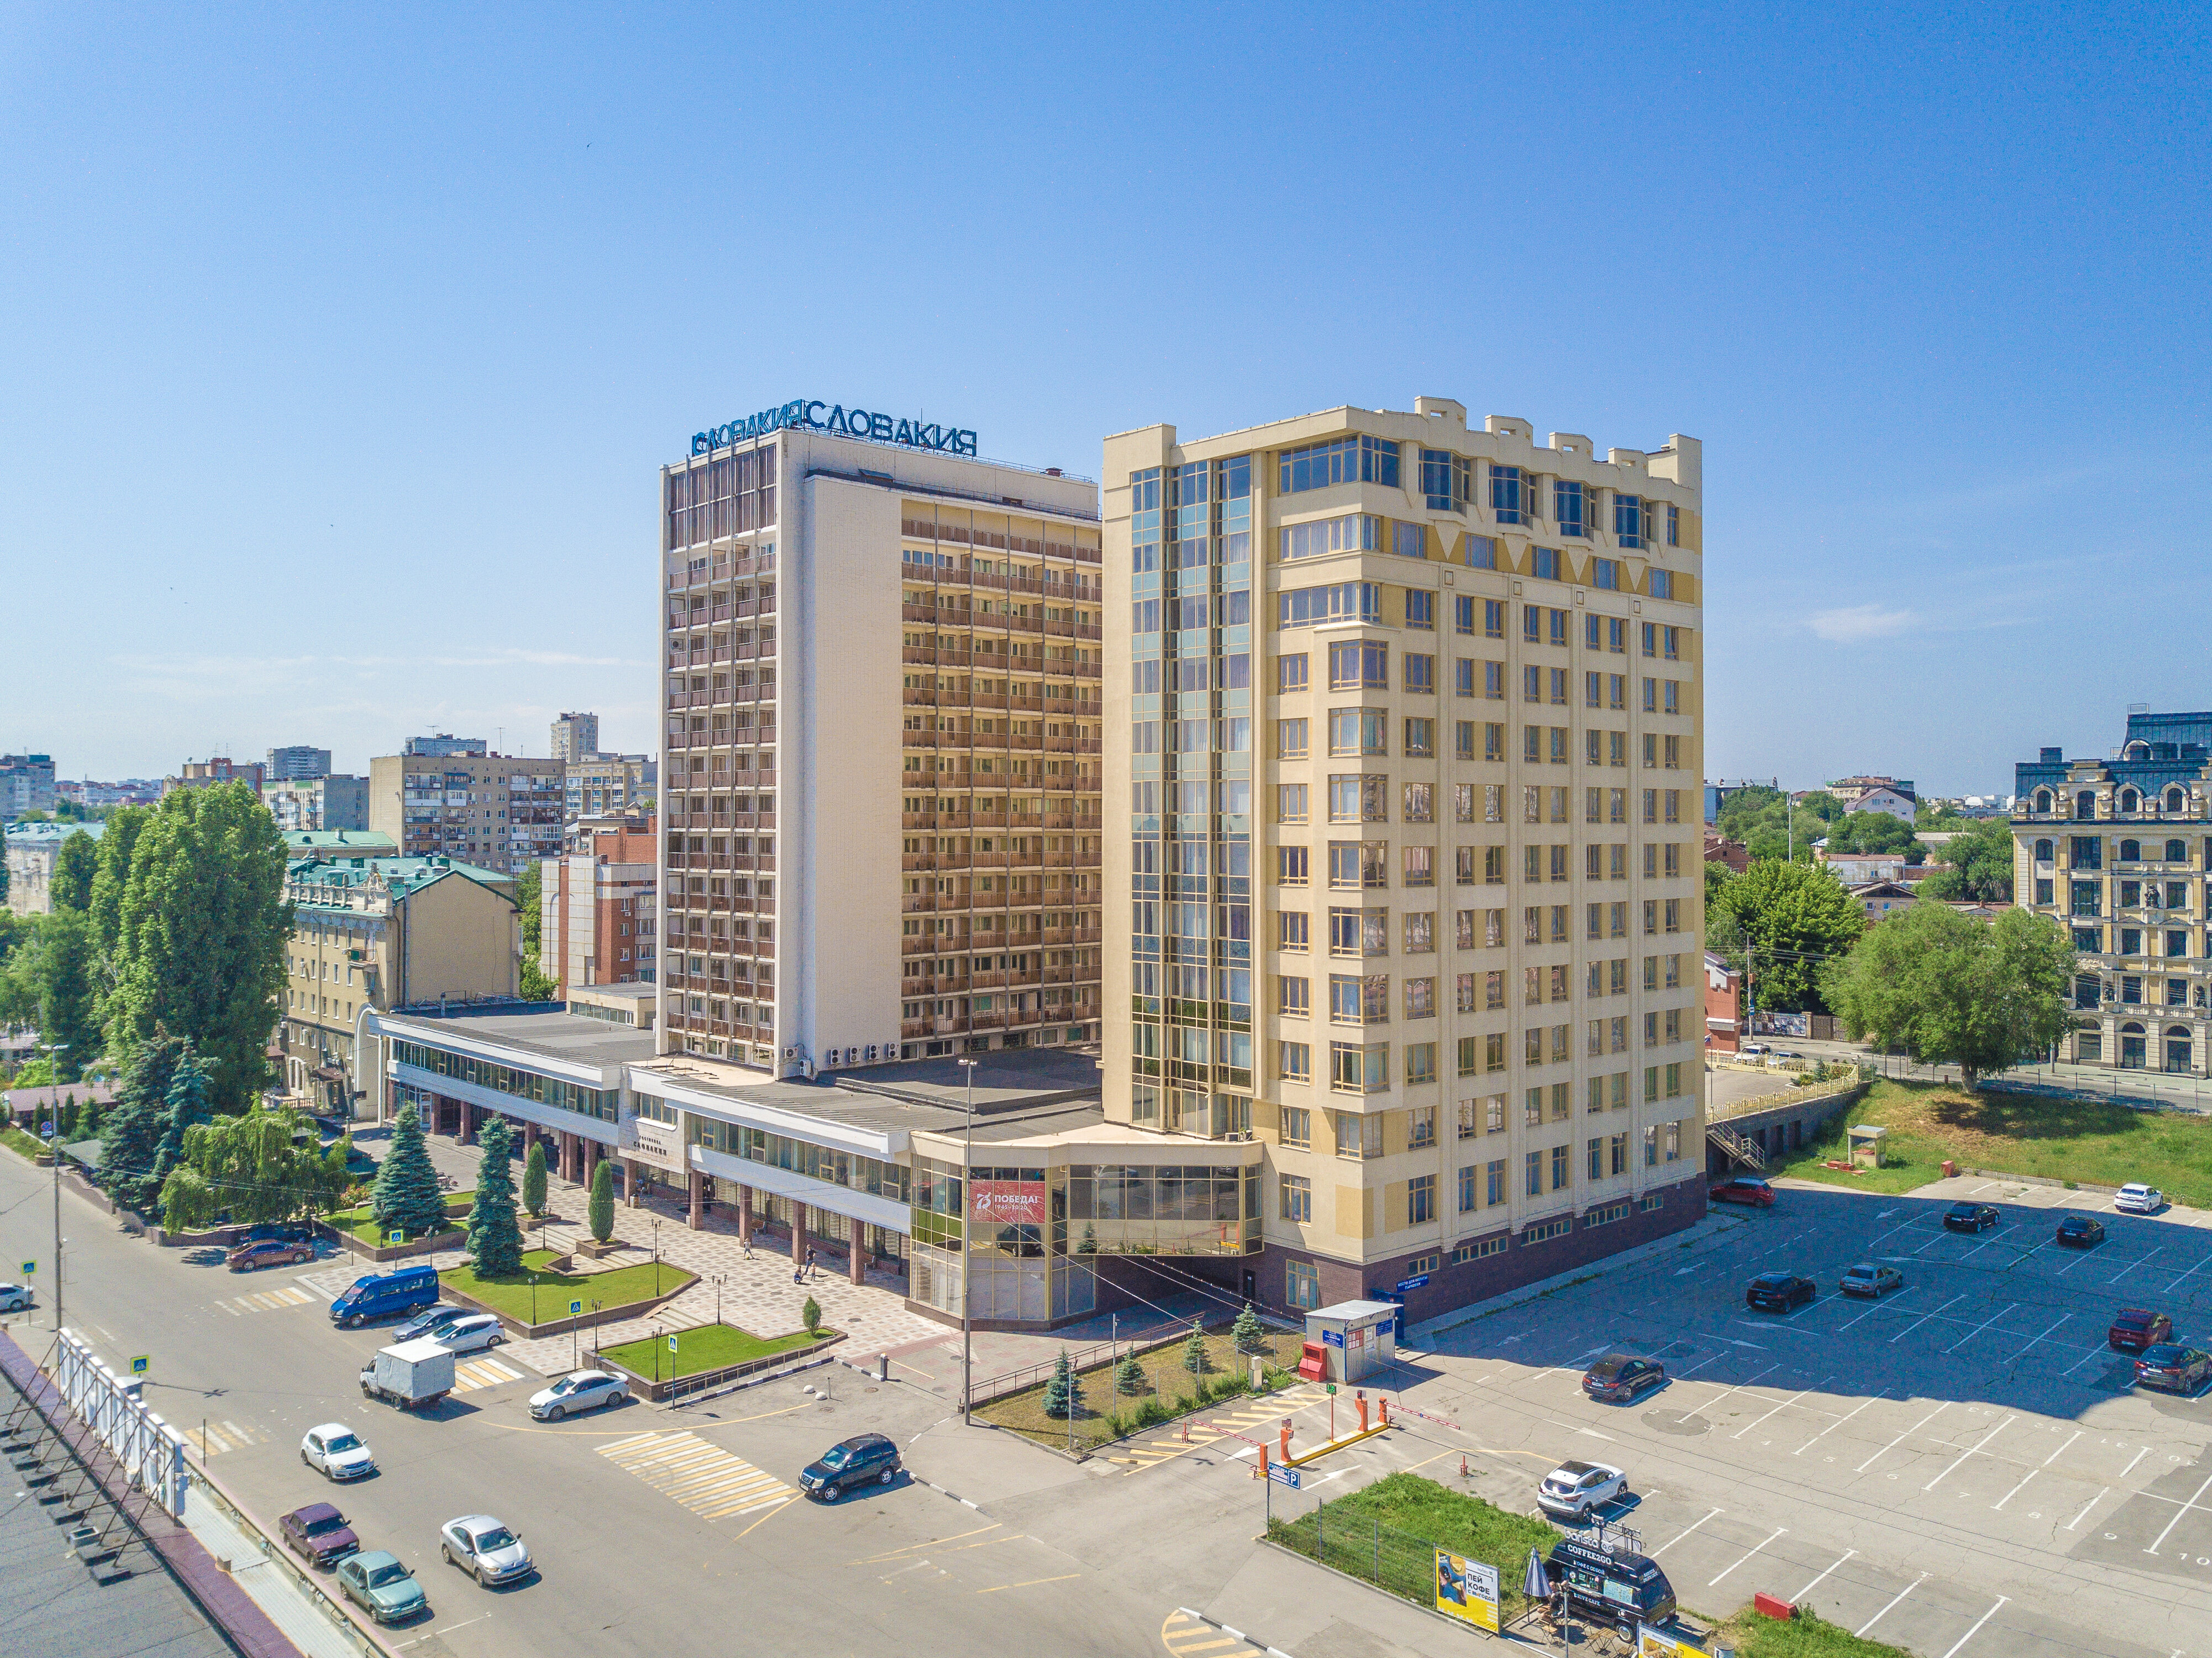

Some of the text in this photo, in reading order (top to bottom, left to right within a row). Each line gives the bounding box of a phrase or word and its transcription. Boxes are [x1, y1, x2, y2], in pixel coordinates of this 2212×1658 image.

[806, 400, 976, 457] СЛОВАКИЯ
[995, 1195, 1038, 1204] ПОБЕДА!
[1291, 1473, 1296, 1484] P
[1567, 1544, 1611, 1565] COFFEE2GO
[1468, 1573, 1483, 1584] ПЕЙ
[1468, 1582, 1490, 1594] КОФЕ
